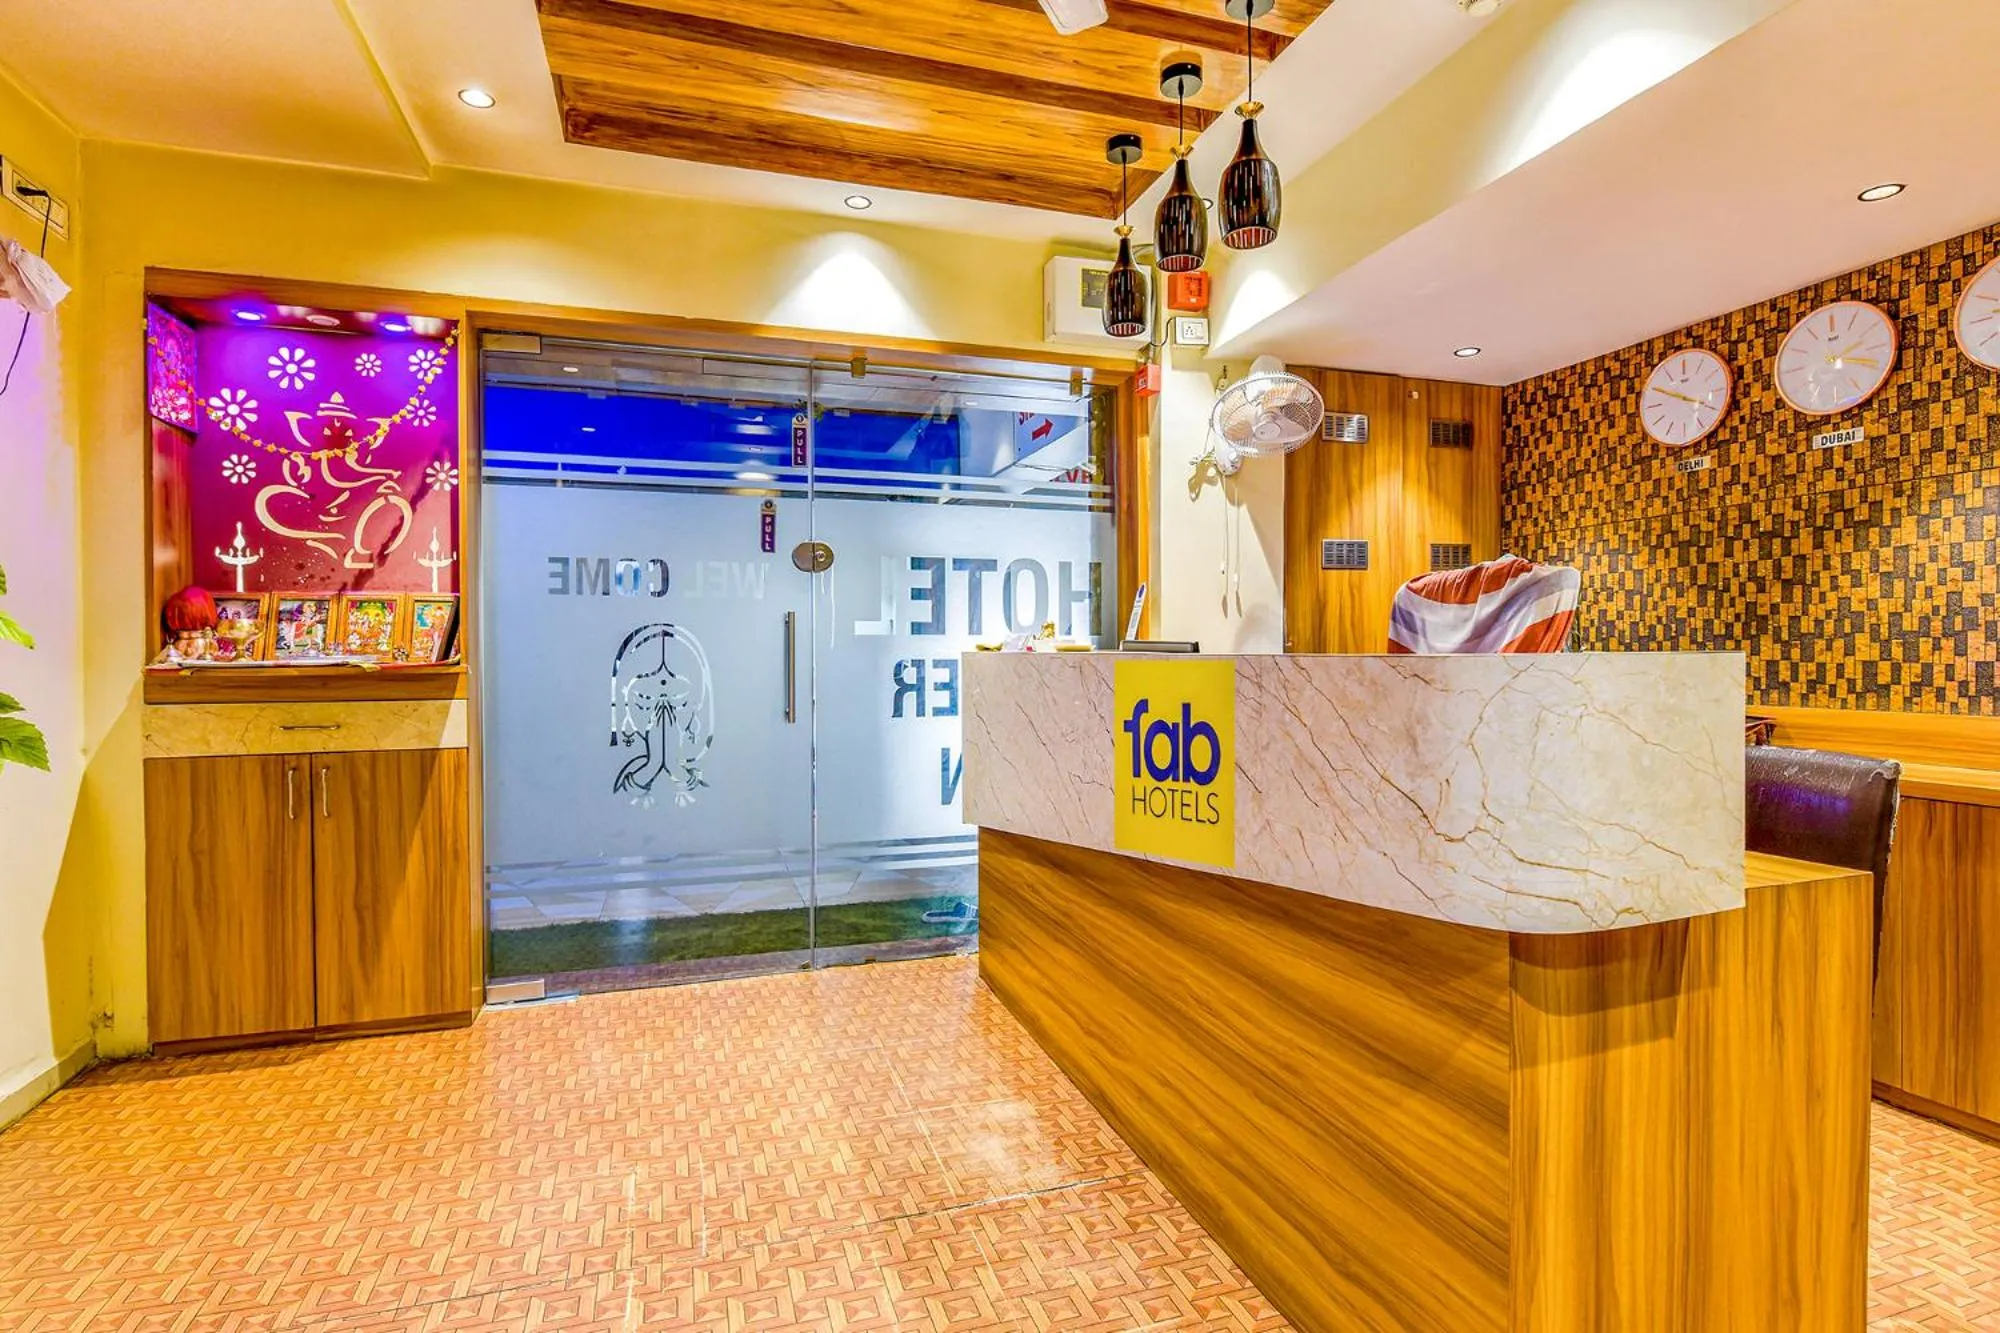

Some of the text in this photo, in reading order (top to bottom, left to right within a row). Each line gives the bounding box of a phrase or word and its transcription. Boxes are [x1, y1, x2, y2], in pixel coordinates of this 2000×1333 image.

[796, 429, 804, 465] PULL
[1820, 430, 1856, 446] DUBAI
[1678, 459, 1703, 471] DELHI
[764, 516, 772, 550] PULL
[1123, 698, 1221, 786] fab
[1132, 786, 1220, 824] HOTELS
